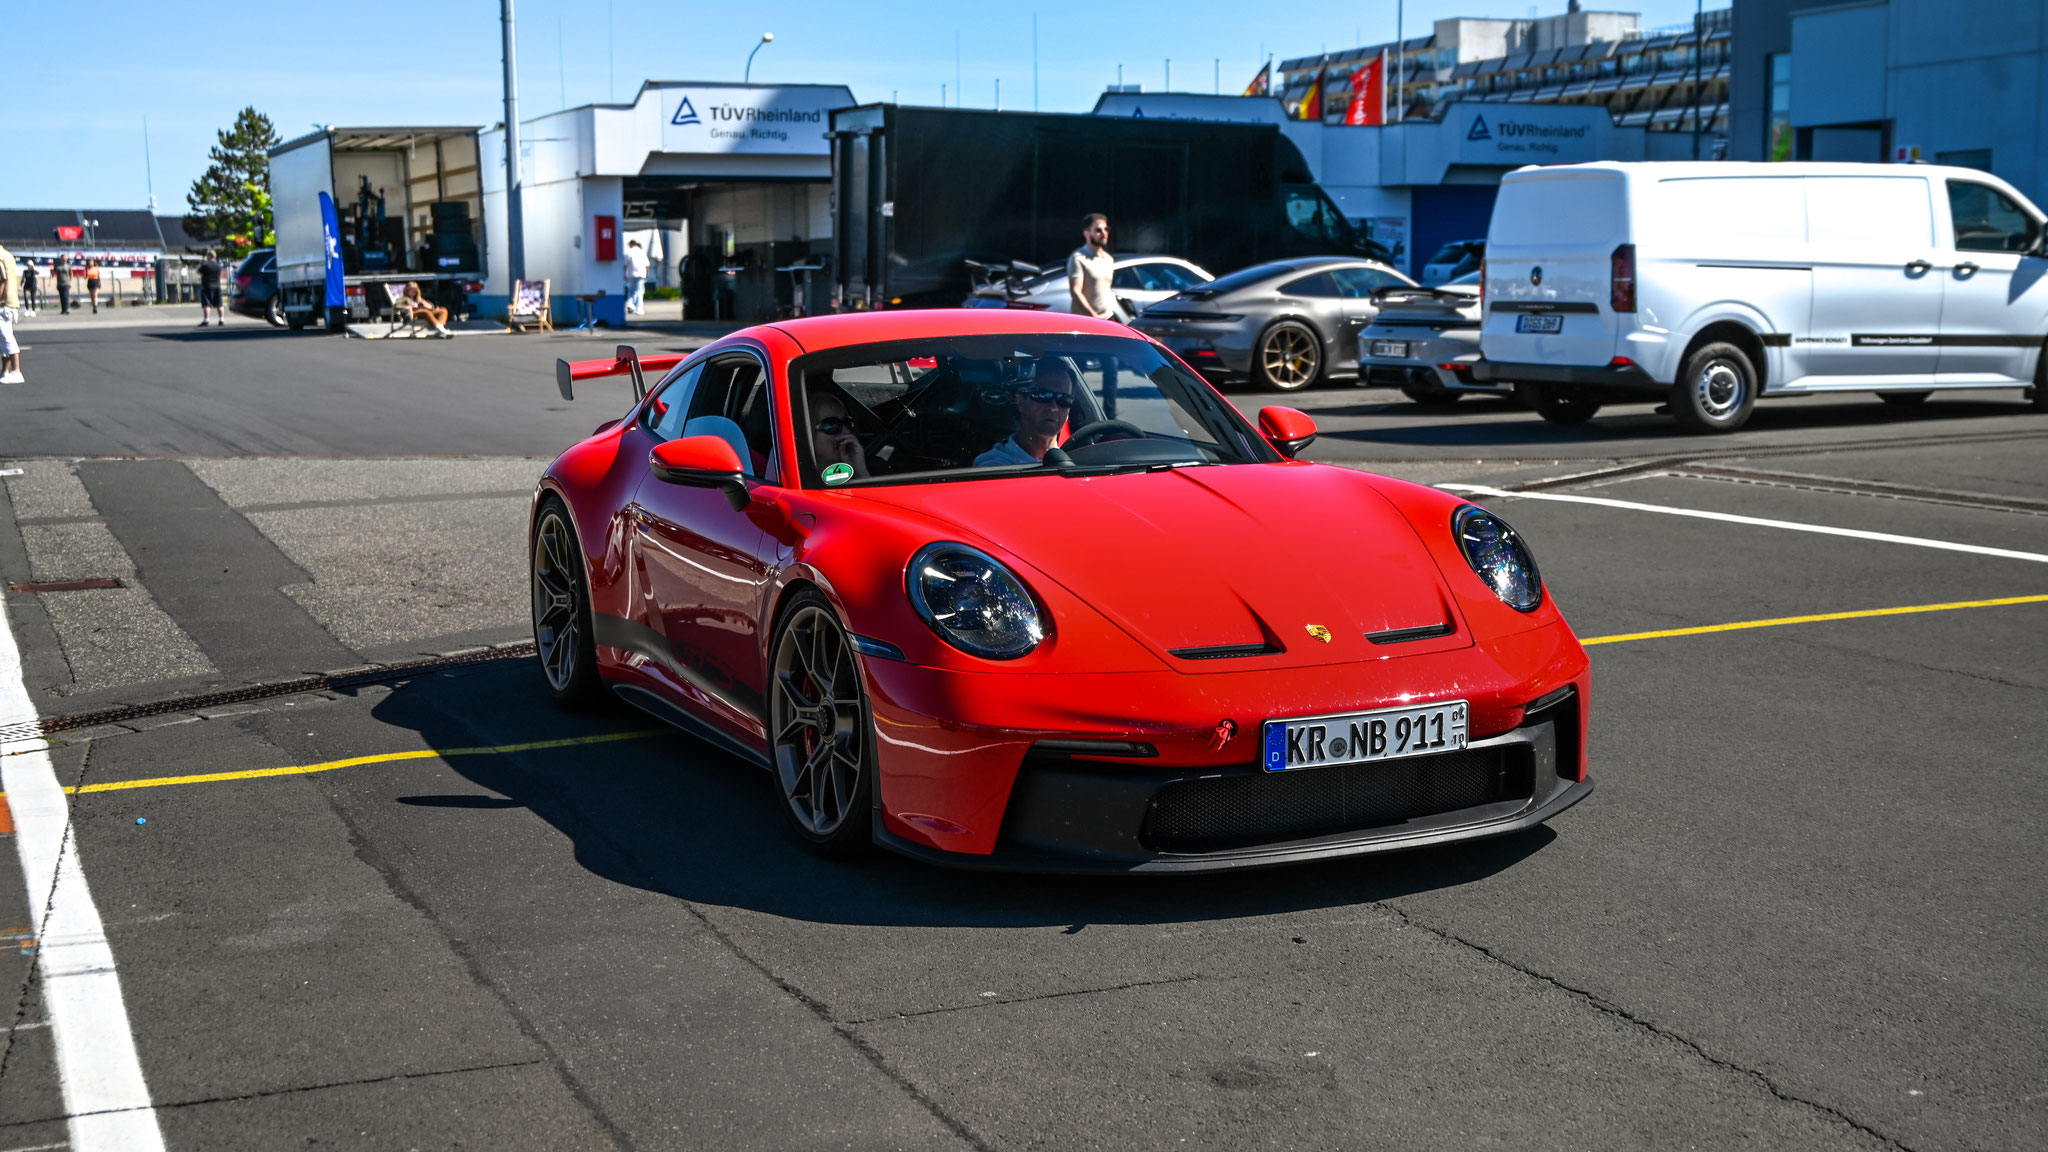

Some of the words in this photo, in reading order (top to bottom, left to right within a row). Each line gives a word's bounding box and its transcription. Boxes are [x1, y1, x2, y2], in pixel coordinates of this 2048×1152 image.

[709, 103, 821, 123] TÜVRheinland
[710, 128, 748, 139] Genau.
[751, 128, 790, 142] Richtig.
[1498, 121, 1585, 138] TÜVRheinland
[832, 464, 843, 474] 4
[1271, 751, 1280, 762] D
[1287, 724, 1327, 764] KR
[1351, 719, 1388, 758] NB
[1395, 711, 1446, 754] 911
